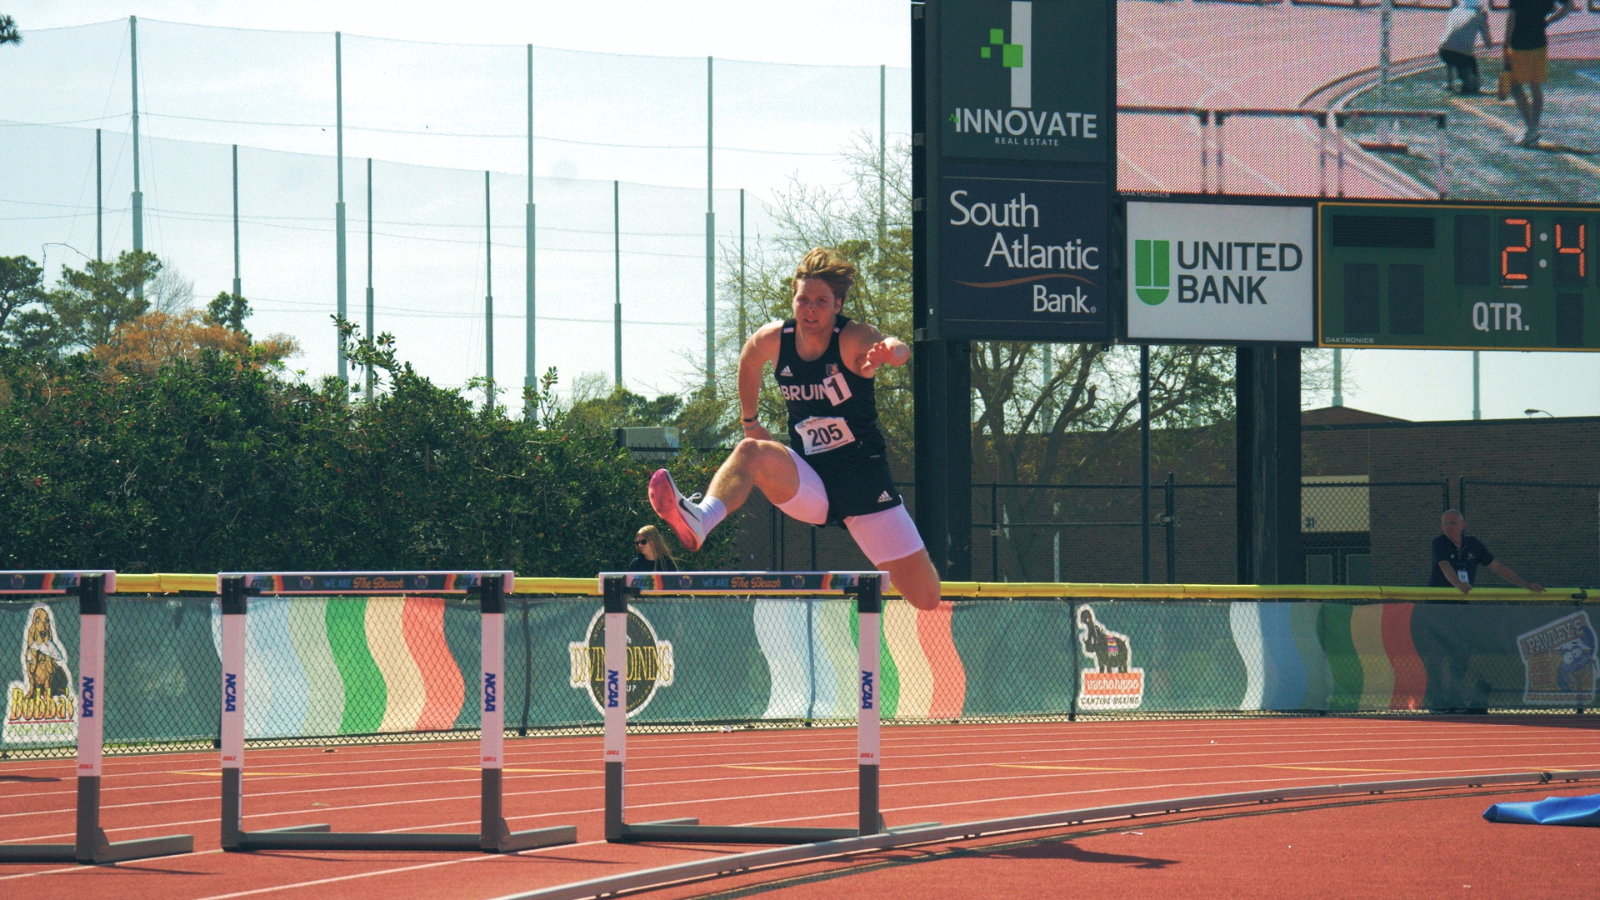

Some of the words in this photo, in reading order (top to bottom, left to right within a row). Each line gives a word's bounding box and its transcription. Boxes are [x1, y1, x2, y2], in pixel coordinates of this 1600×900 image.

[955, 107, 1097, 138] INNOVATE
[995, 136, 1019, 146] REAL
[1023, 137, 1060, 147] ESTATE
[950, 189, 1040, 228] South
[984, 232, 1100, 270] Atlantic
[1177, 240, 1303, 272] UNITED
[1177, 274, 1268, 305] BANK
[1472, 301, 1530, 332] QTR.
[1325, 336, 1375, 344] DAKTRONICS
[807, 423, 843, 447] 205
[324, 579, 336, 588] WE
[353, 576, 371, 590] The
[373, 576, 404, 589] Beach
[702, 578, 715, 588] WE
[716, 578, 730, 587] ARE
[731, 576, 750, 589] The
[751, 576, 781, 589] Beach
[9, 687, 75, 720] Bubba's
[81, 676, 95, 718] NCAA
[225, 672, 236, 712] NCAA
[484, 672, 496, 712] NCAA
[608, 669, 619, 708] NCAA
[861, 670, 873, 710] NCAA
